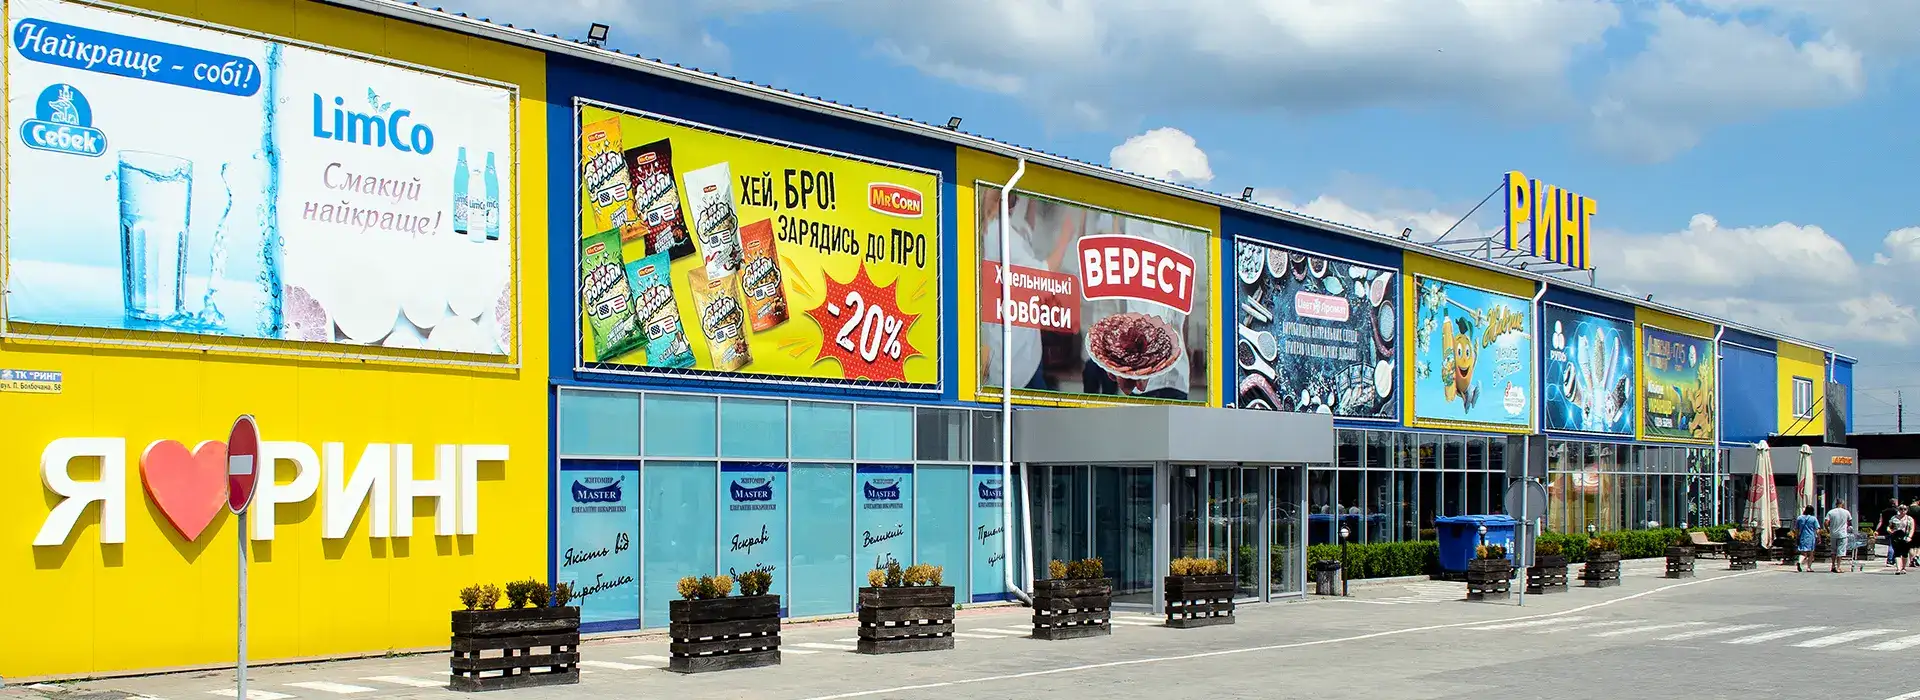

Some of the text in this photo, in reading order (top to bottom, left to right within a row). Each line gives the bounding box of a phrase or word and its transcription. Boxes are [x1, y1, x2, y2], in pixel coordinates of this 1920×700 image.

[18, 22, 163, 78] Найкраще
[193, 60, 254, 89] собі!
[32, 124, 98, 153] Себек
[313, 92, 434, 155] LimCo
[323, 161, 423, 205] Смакуй
[587, 152, 623, 190] POPCORN
[638, 173, 672, 209] POPCORN
[740, 169, 836, 211] ХЕЙ, БРО!
[302, 200, 442, 239] найкраще!
[1504, 170, 1597, 270] РИНГ
[778, 215, 860, 256] ЗАРЯДИСЬ
[890, 229, 926, 269] ПРО
[587, 264, 621, 304] POPCORN
[1084, 247, 1191, 300] ВЕРЕСТ
[639, 285, 671, 321] POPCORN
[827, 290, 903, 363] -20%
[15, 370, 28, 379] ТК
[33, 437, 510, 546] Я РИНГ
[577, 490, 616, 500] MASTER
[735, 490, 768, 499] MASTER
[868, 490, 896, 498] MASTER
[982, 489, 1003, 497] MASTE
[563, 532, 630, 568] Якість від
[731, 524, 770, 555] Яскраві
[863, 524, 904, 548] Великий
[569, 573, 634, 605] виробника
